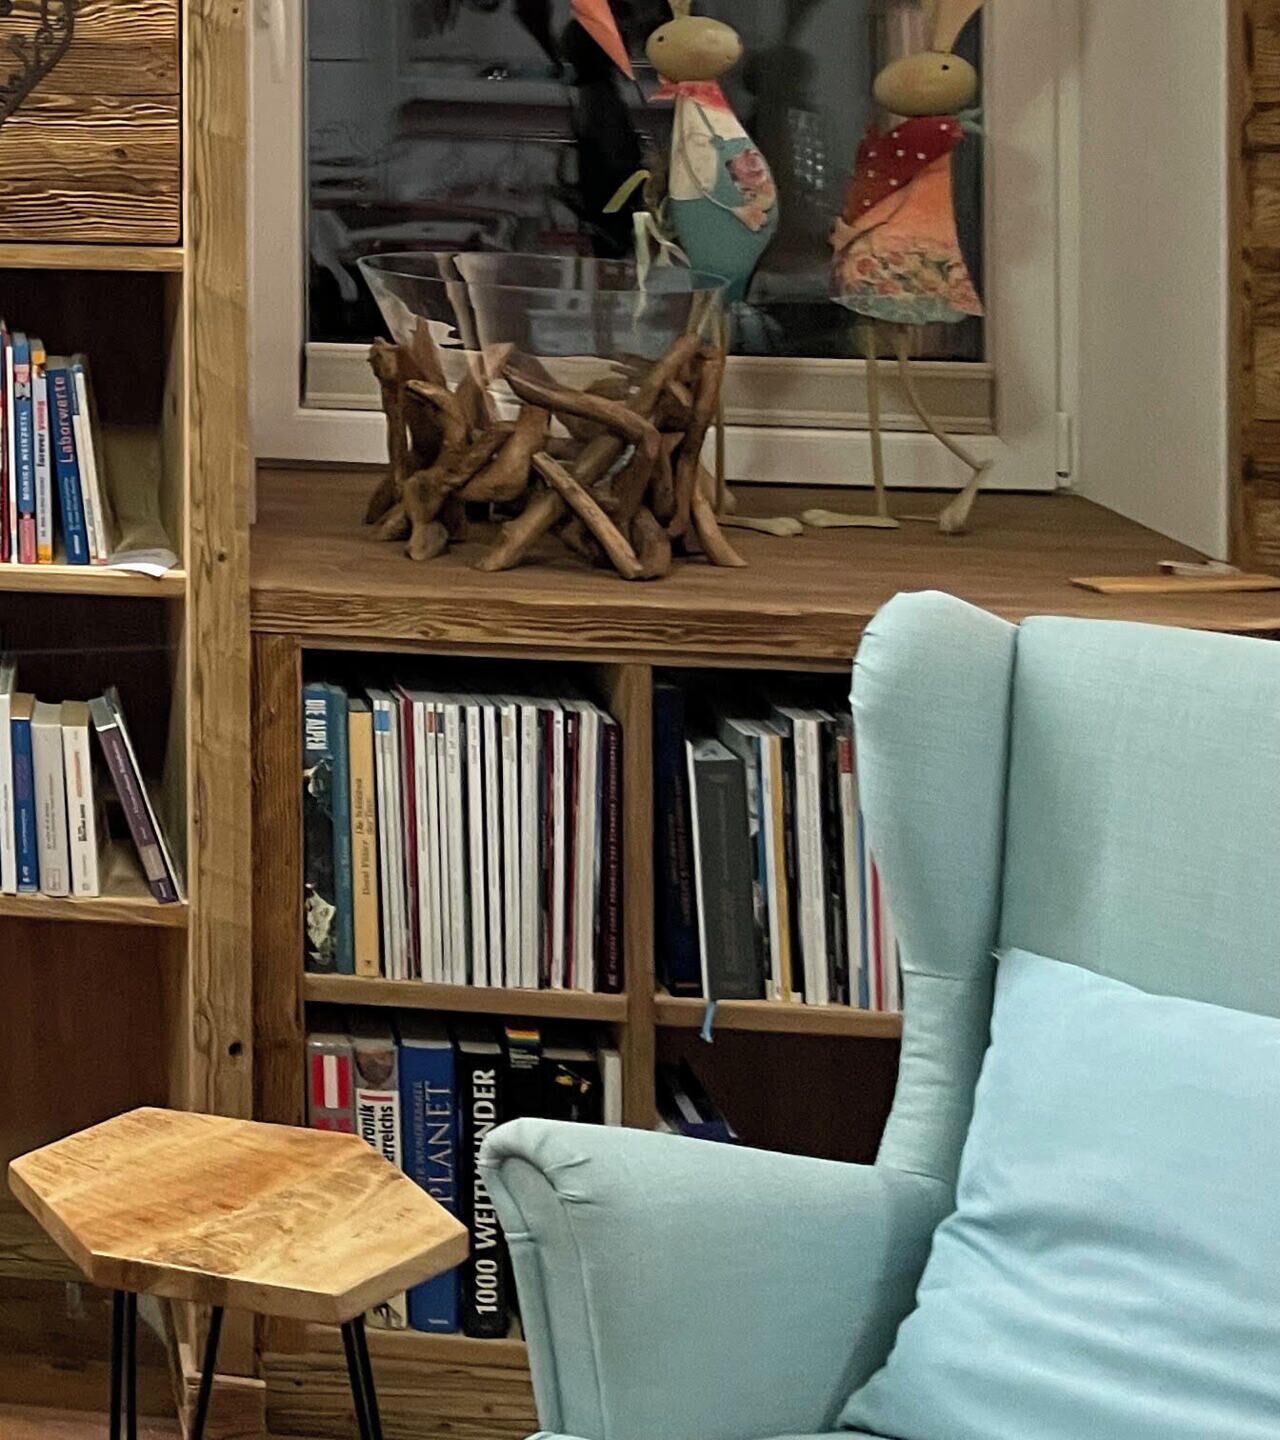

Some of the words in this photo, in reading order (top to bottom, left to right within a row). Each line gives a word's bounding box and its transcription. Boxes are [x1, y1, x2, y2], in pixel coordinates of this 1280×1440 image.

[53, 376, 74, 463] Laborwerte
[37, 433, 46, 467] forever
[304, 698, 327, 717] DIE
[304, 718, 328, 752] ALPEN
[380, 1106, 393, 1158] erreichs
[427, 1081, 454, 1202] PLANET
[476, 1259, 498, 1314] 1000
